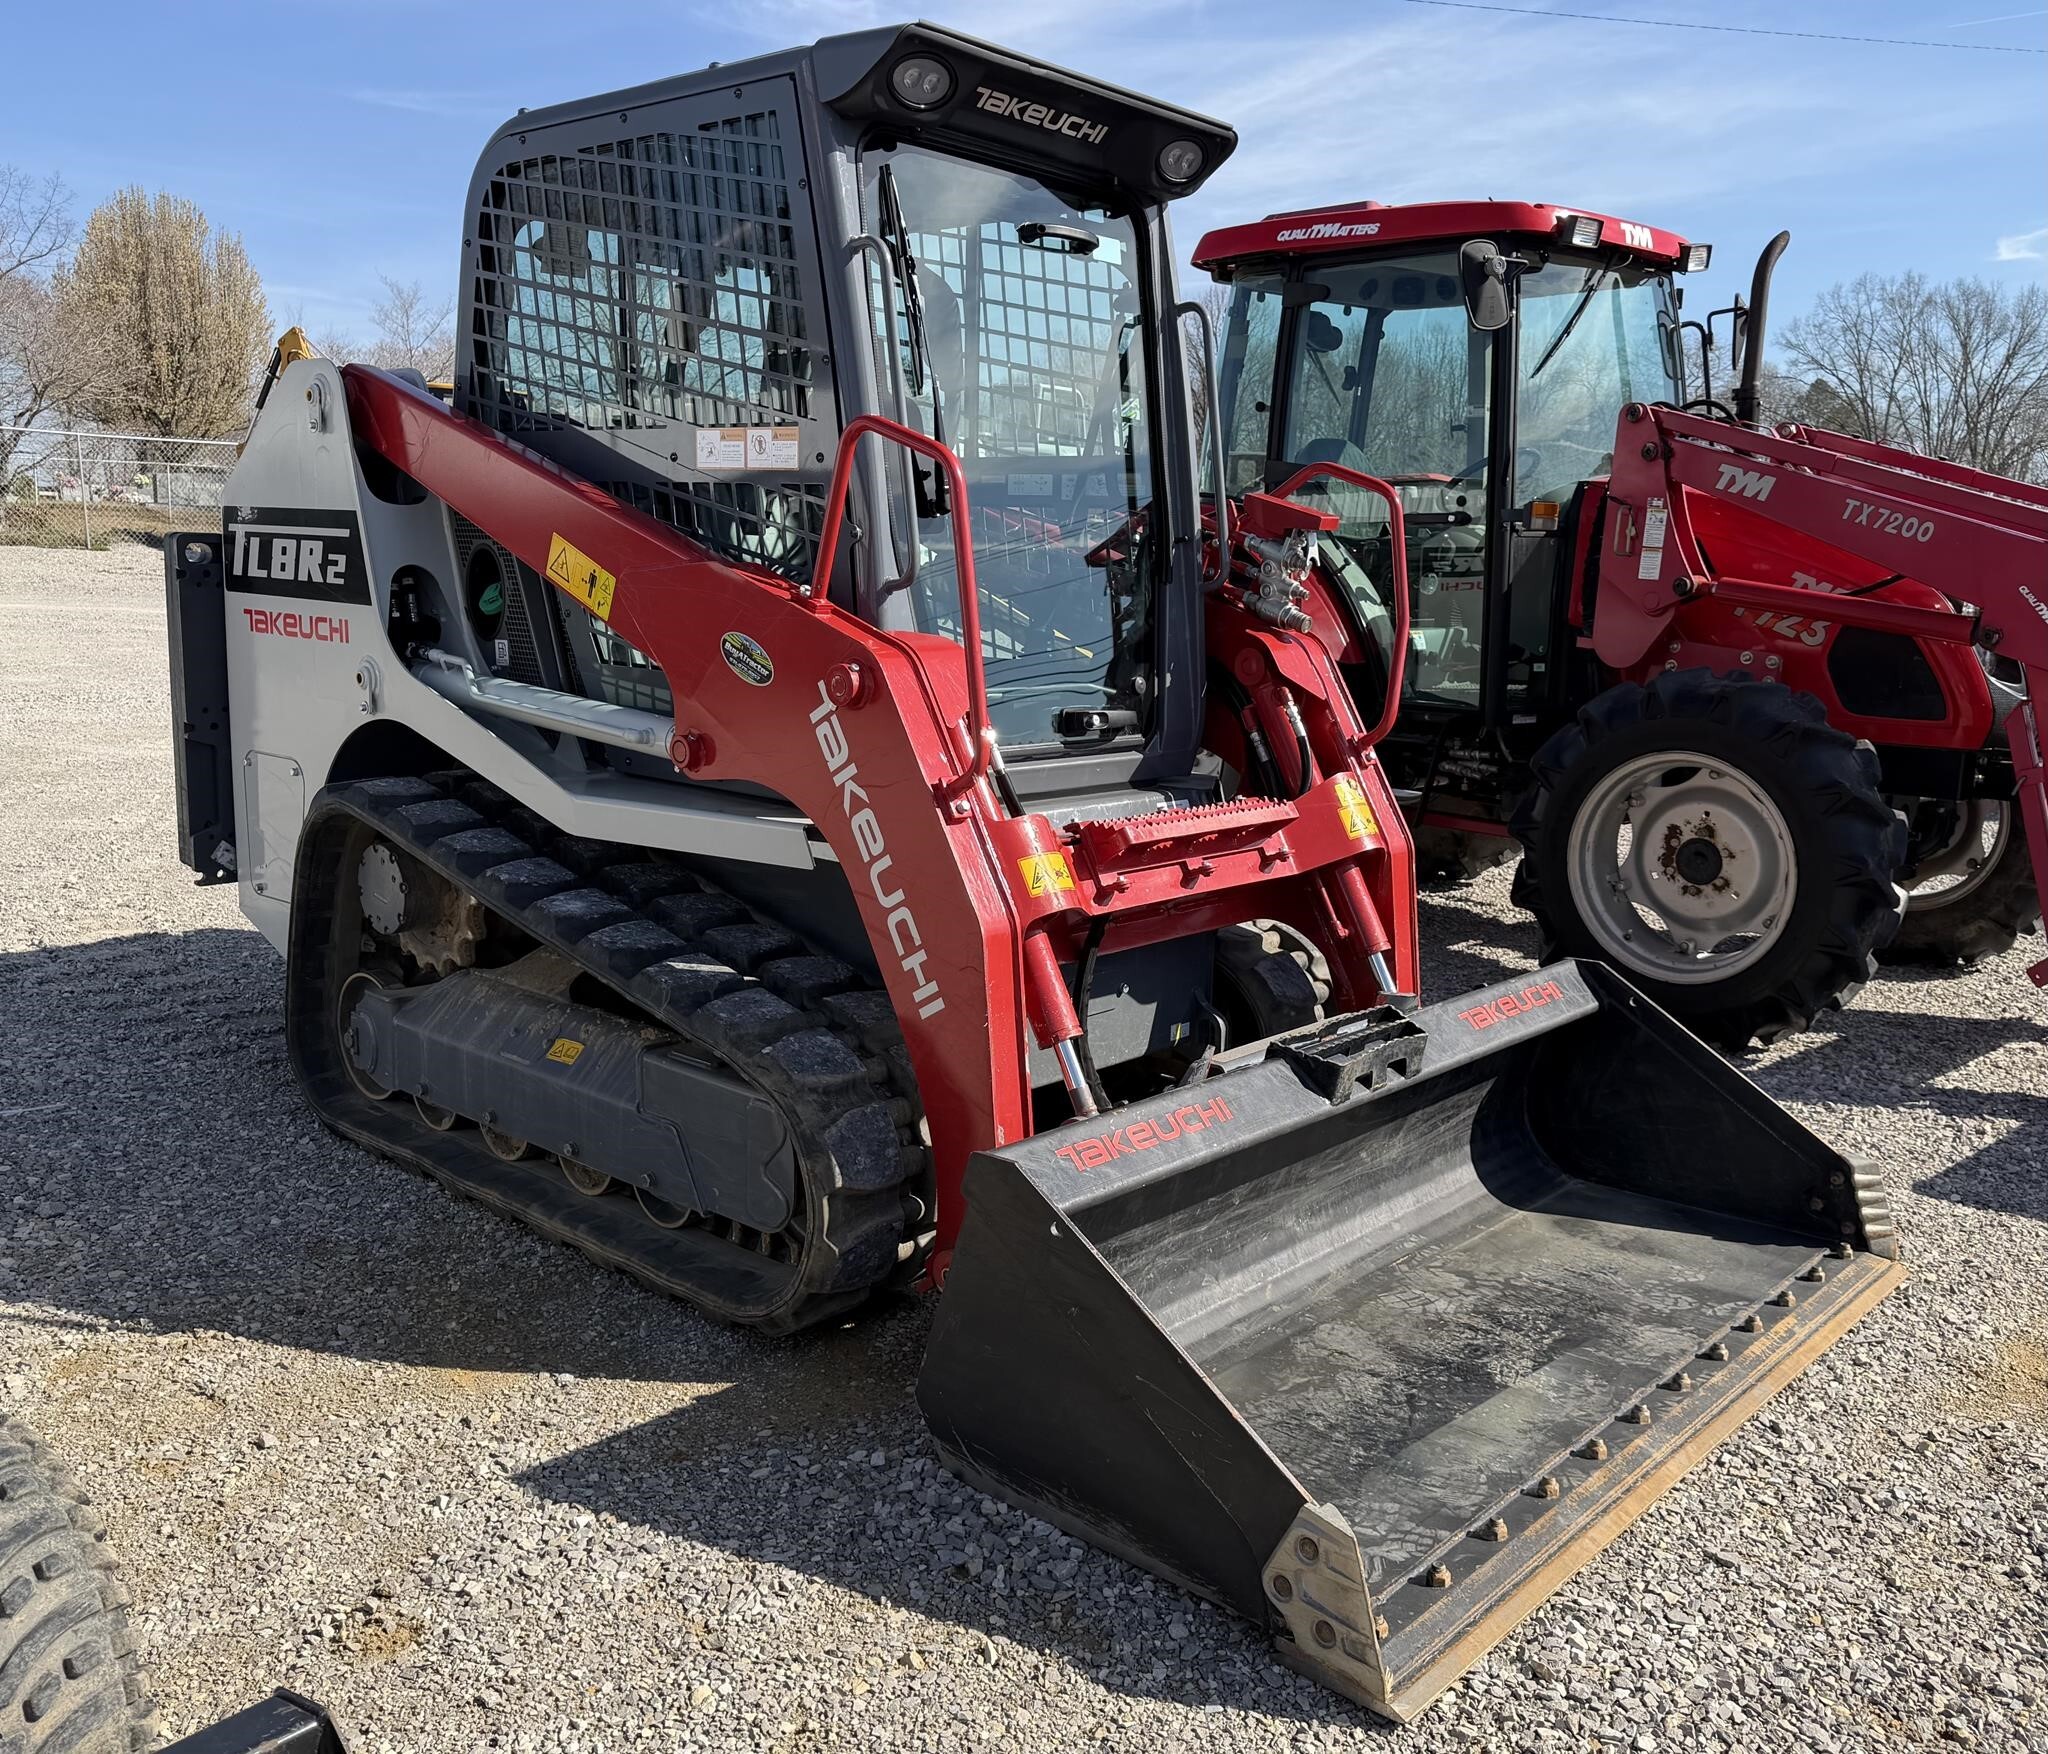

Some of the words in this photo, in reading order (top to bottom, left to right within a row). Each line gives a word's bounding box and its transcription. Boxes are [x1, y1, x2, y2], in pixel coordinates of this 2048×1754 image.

[976, 86, 1109, 144] TAKEUCHI
[1619, 222, 1654, 249] TYM
[1715, 463, 1777, 502] TYM
[1842, 498, 1935, 543] TX7200
[228, 523, 350, 585] TL8R2
[243, 608, 350, 644] TAKEUCHI
[808, 679, 946, 1021] TAKEUCHI
[1457, 980, 1564, 1030] TAKEUCHI
[1054, 1096, 1234, 1173] TAKEUCHI
